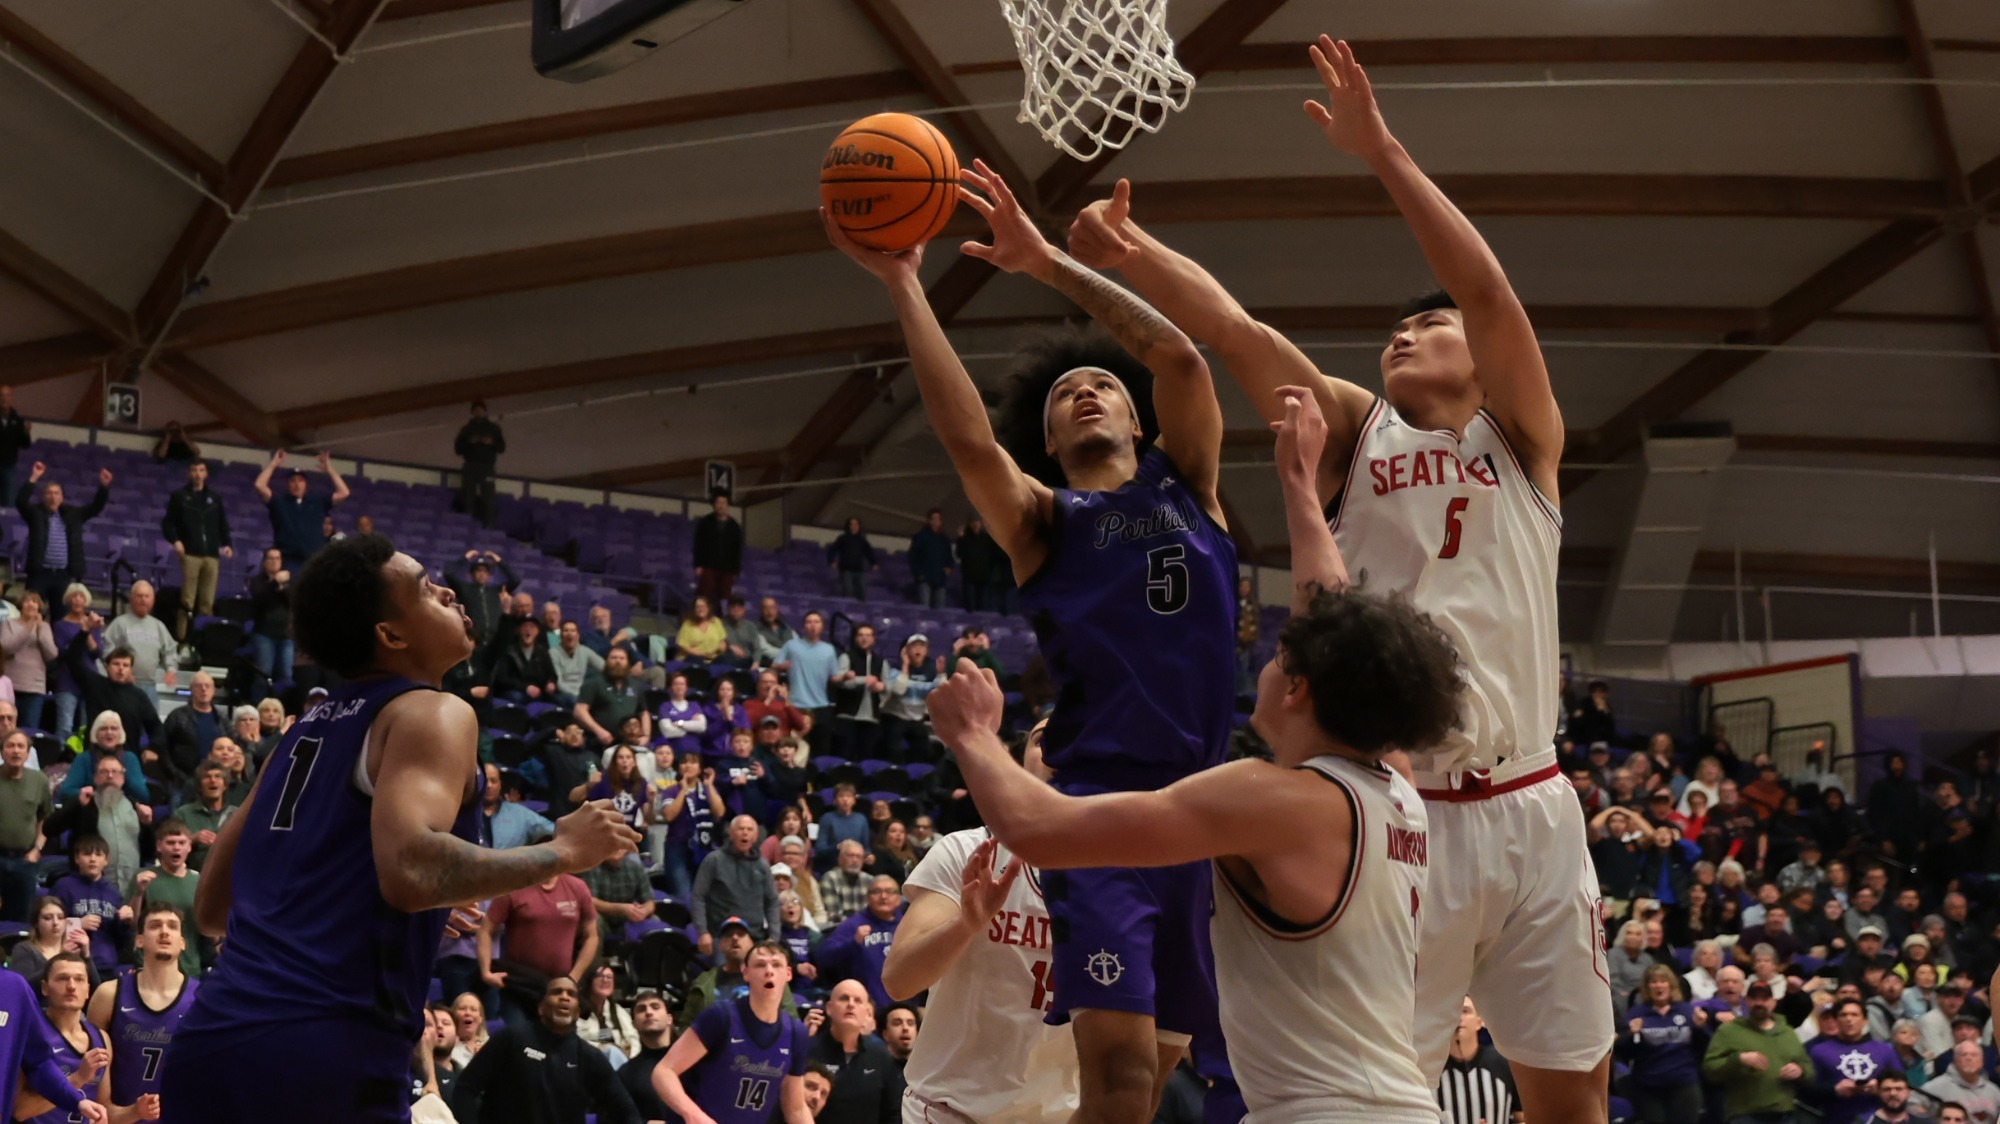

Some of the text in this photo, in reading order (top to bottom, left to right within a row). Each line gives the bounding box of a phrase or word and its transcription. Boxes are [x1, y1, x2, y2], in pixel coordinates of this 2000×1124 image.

[822, 143, 895, 171] Wilson
[111, 393, 135, 417] 13
[710, 468, 728, 489] 14
[1369, 449, 1498, 496] SEATTE
[1094, 501, 1198, 550] Portlad
[1146, 543, 1189, 615] 5
[270, 736, 324, 831] 1
[988, 910, 1052, 949] SEAT
[141, 1046, 163, 1081] 7
[735, 1077, 770, 1111] 14
